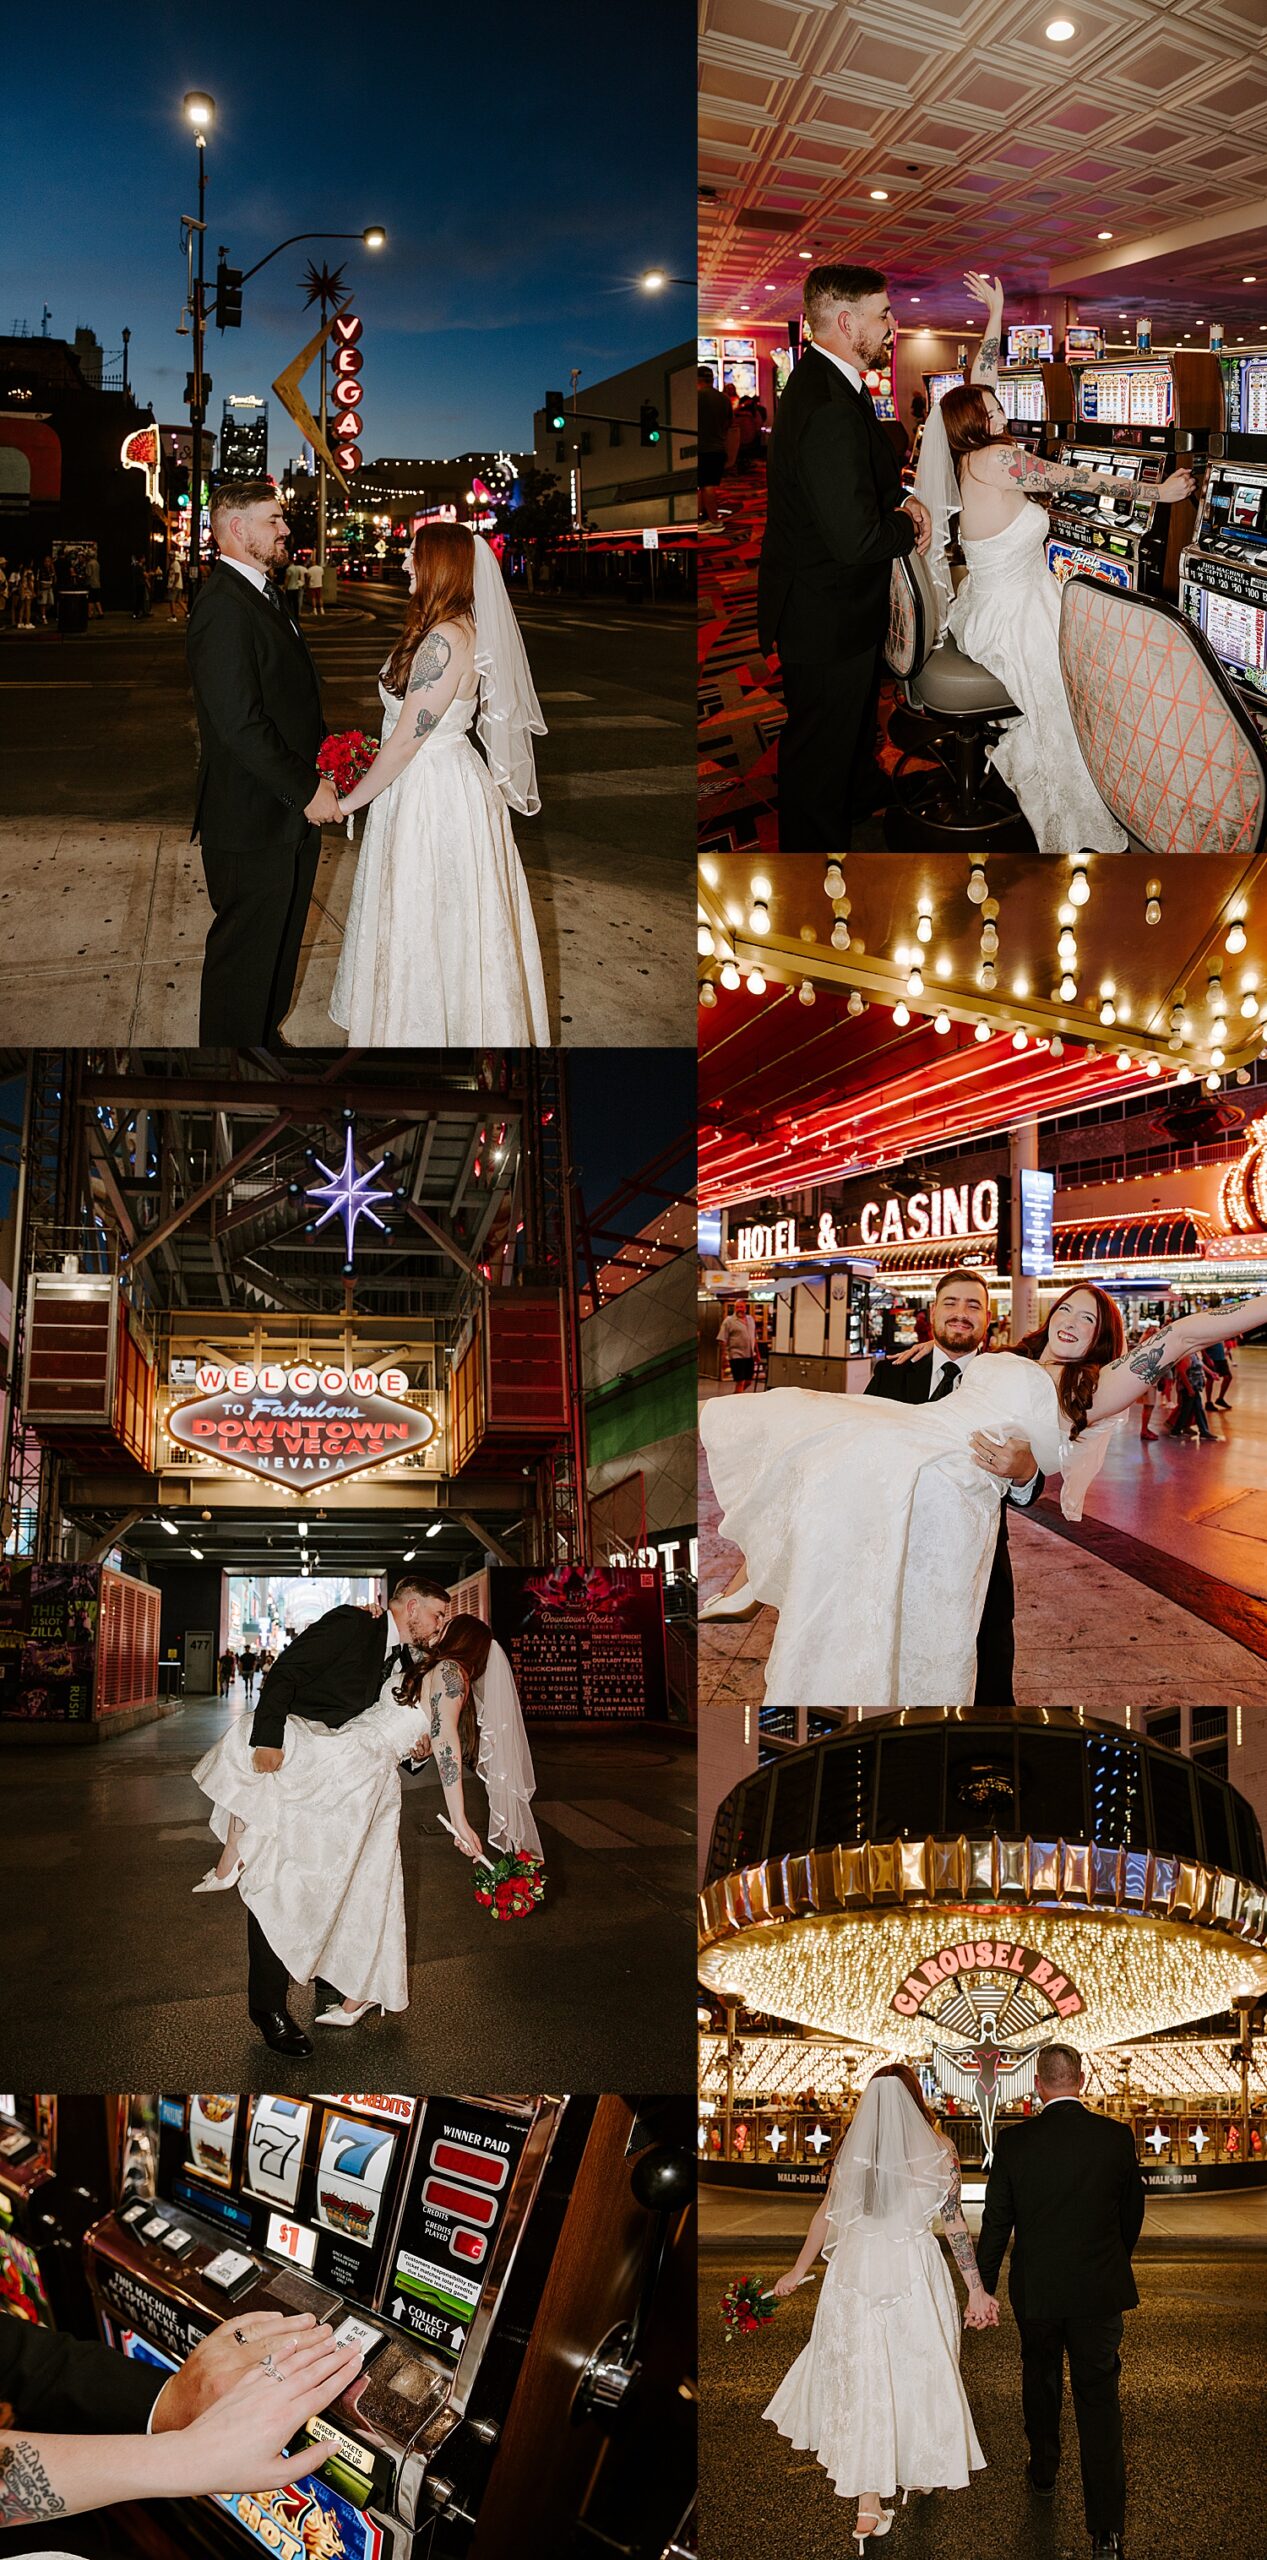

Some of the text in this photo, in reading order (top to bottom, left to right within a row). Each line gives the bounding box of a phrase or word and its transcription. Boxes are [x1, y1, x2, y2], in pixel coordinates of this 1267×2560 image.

[337, 318, 361, 470] VEGAS
[1070, 547, 1101, 568] Triple
[1197, 566, 1249, 586] ACCEPTS TICKETS
[1202, 562, 1244, 578] THIS MACHINE
[1207, 575, 1215, 585] $10
[1219, 579, 1228, 589] $20
[1232, 583, 1242, 593] $50
[1245, 587, 1259, 599] $100
[738, 1219, 800, 1260] HOTEL
[818, 1212, 838, 1250] &
[860, 1180, 999, 1244] CASINO
[201, 1372, 401, 1390] WELCOME
[222, 1398, 366, 1420] TO Fabulous
[192, 1420, 408, 1439] DOWNTOWN
[219, 1438, 384, 1454] LAS VEGAS
[258, 1457, 345, 1469] NEVADA
[32, 1605, 64, 1616] THIS
[541, 1612, 614, 1624] Downtown Rocks
[30, 1627, 62, 1638] ZILLA
[190, 1640, 209, 1650] 477
[68, 1685, 80, 1719] RUSH
[894, 1942, 1081, 2018] CAROUSEL BAR
[353, 2094, 411, 2117] CREDITS
[253, 2122, 300, 2180] 7
[443, 2125, 510, 2154] WINNER PAID
[778, 2173, 827, 2184] WALK-UP BAR
[1148, 2175, 1197, 2185] WALK-UP BAR
[422, 2206, 449, 2221] CREDITS
[424, 2228, 449, 2242] PLAYED
[425, 2220, 452, 2236] CREDITS
[279, 2224, 299, 2256] $1
[404, 2254, 479, 2290] Customers responsibility that
[405, 2261, 473, 2295] ticket matches total credits
[407, 2268, 469, 2300] due before leaving game
[115, 2272, 178, 2323] THIS MACHINE
[109, 2279, 186, 2340] ACCEPTS TICKETS
[408, 2305, 450, 2332] COLLECT
[345, 2334, 356, 2342] MA
[351, 2326, 368, 2337] PLAY
[410, 2316, 442, 2340] TICKET
[312, 2429, 361, 2465] OR ACE UP
[315, 2421, 363, 2458] INSERT TICKETS
[16, 2441, 66, 2513] ROMANTIC
[238, 2495, 302, 2560] HOT
